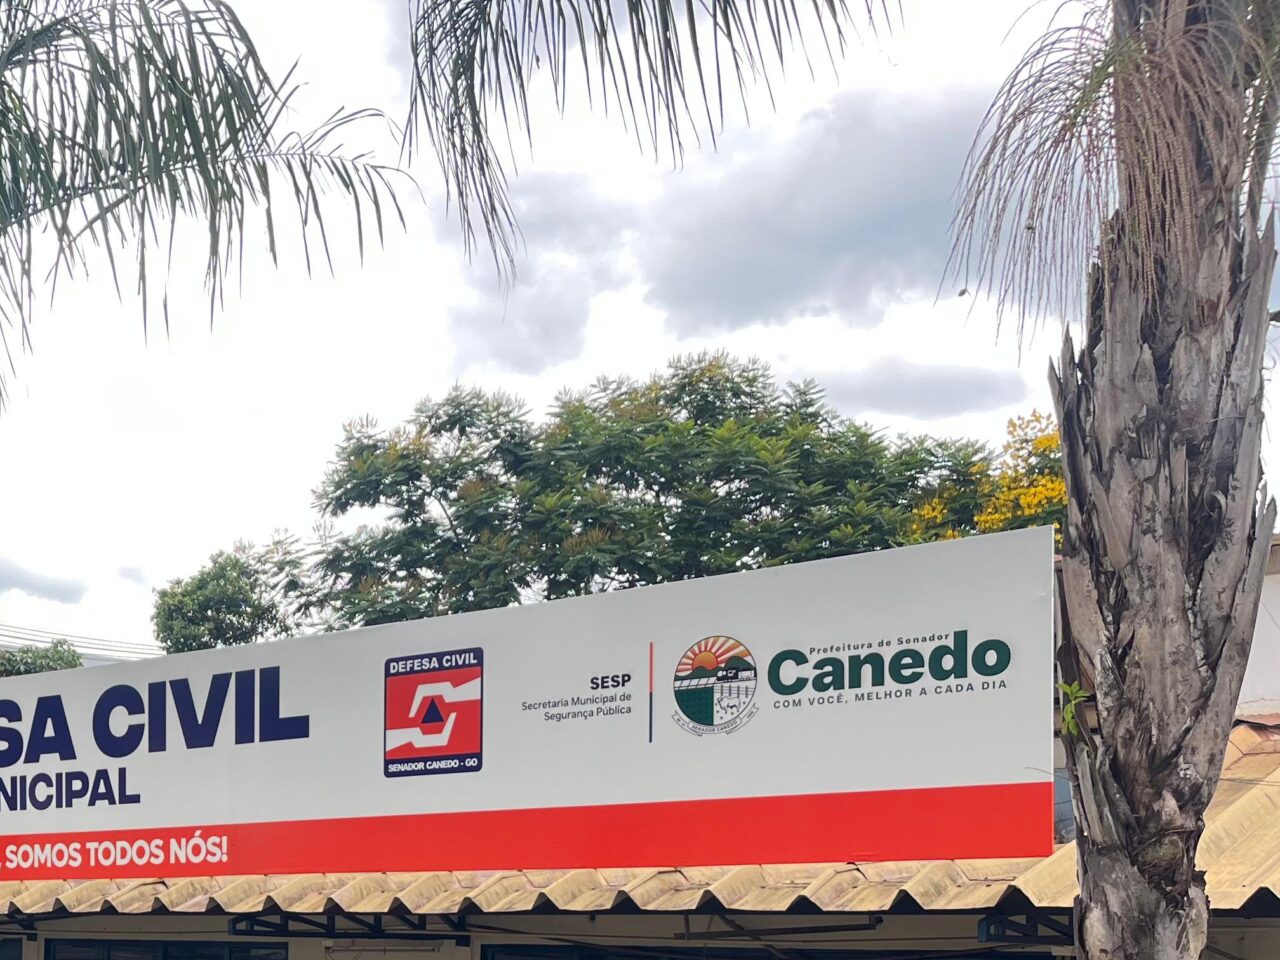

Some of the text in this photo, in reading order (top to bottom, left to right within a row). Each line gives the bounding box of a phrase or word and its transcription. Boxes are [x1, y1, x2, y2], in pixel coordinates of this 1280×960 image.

[809, 633, 950, 656] Prefeitura de Senador
[389, 652, 478, 674] DEFESA CIVIL
[767, 629, 1012, 696] Canedo
[589, 673, 632, 691] SESP
[521, 691, 632, 711] Secretaria Municipal de
[773, 679, 1007, 710] COM VOCÊ, MELHOR A CADA DIA
[92, 665, 311, 759] CIVIL
[543, 704, 632, 723] Segurança Pública
[387, 761, 425, 773] SENADOR
[426, 759, 460, 770] CANEDO
[465, 758, 478, 767] GO
[5, 841, 83, 868] SOMOS
[86, 838, 166, 866] TODOS
[169, 830, 229, 864] NÓS!
